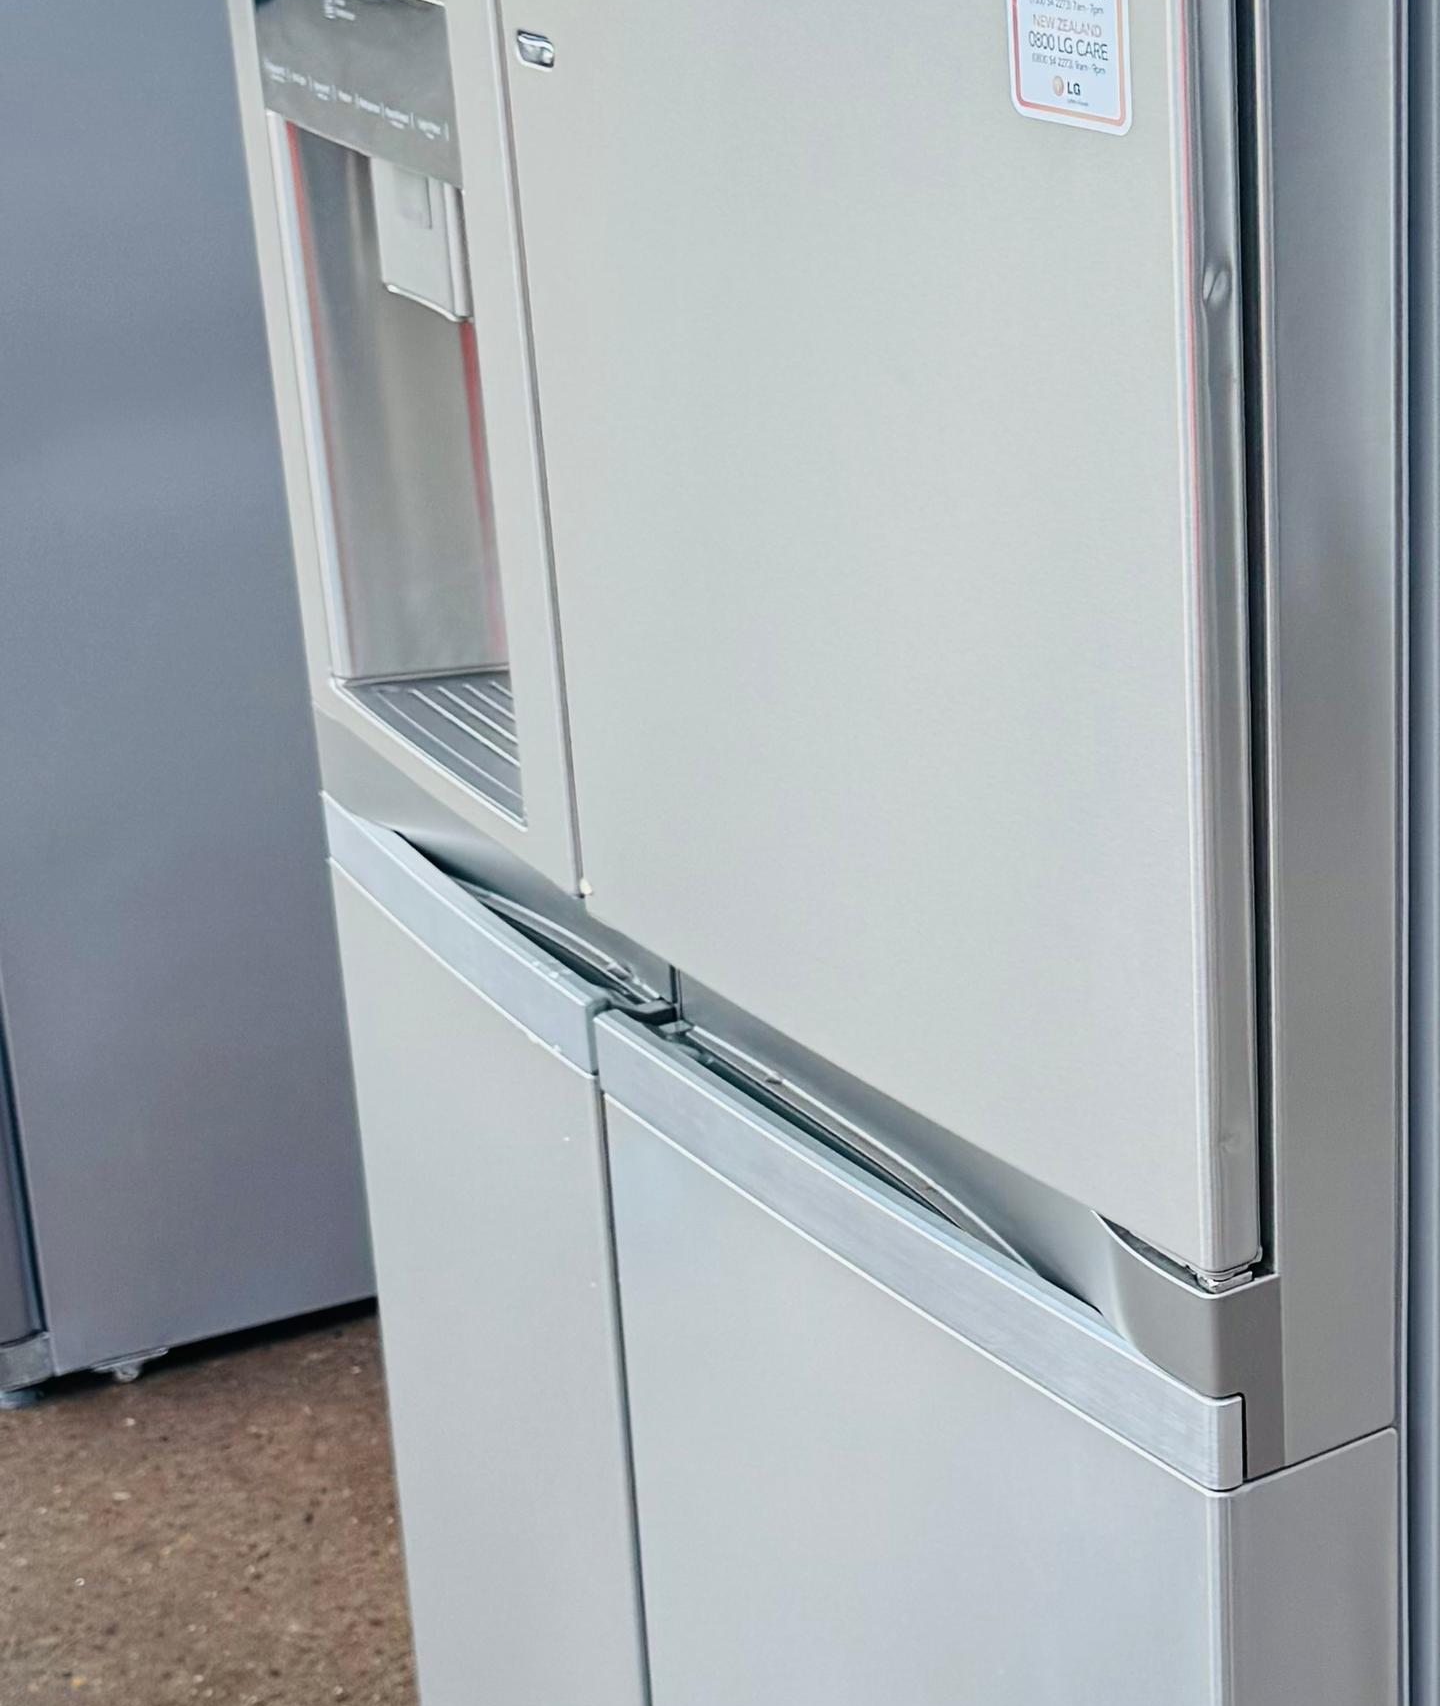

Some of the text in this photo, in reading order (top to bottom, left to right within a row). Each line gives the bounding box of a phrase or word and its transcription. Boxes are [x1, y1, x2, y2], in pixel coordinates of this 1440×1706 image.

[1033, 13, 1102, 38] NEW ZEALAND
[1028, 30, 1109, 61] 0800 LG CARE
[1066, 81, 1082, 97] LG
